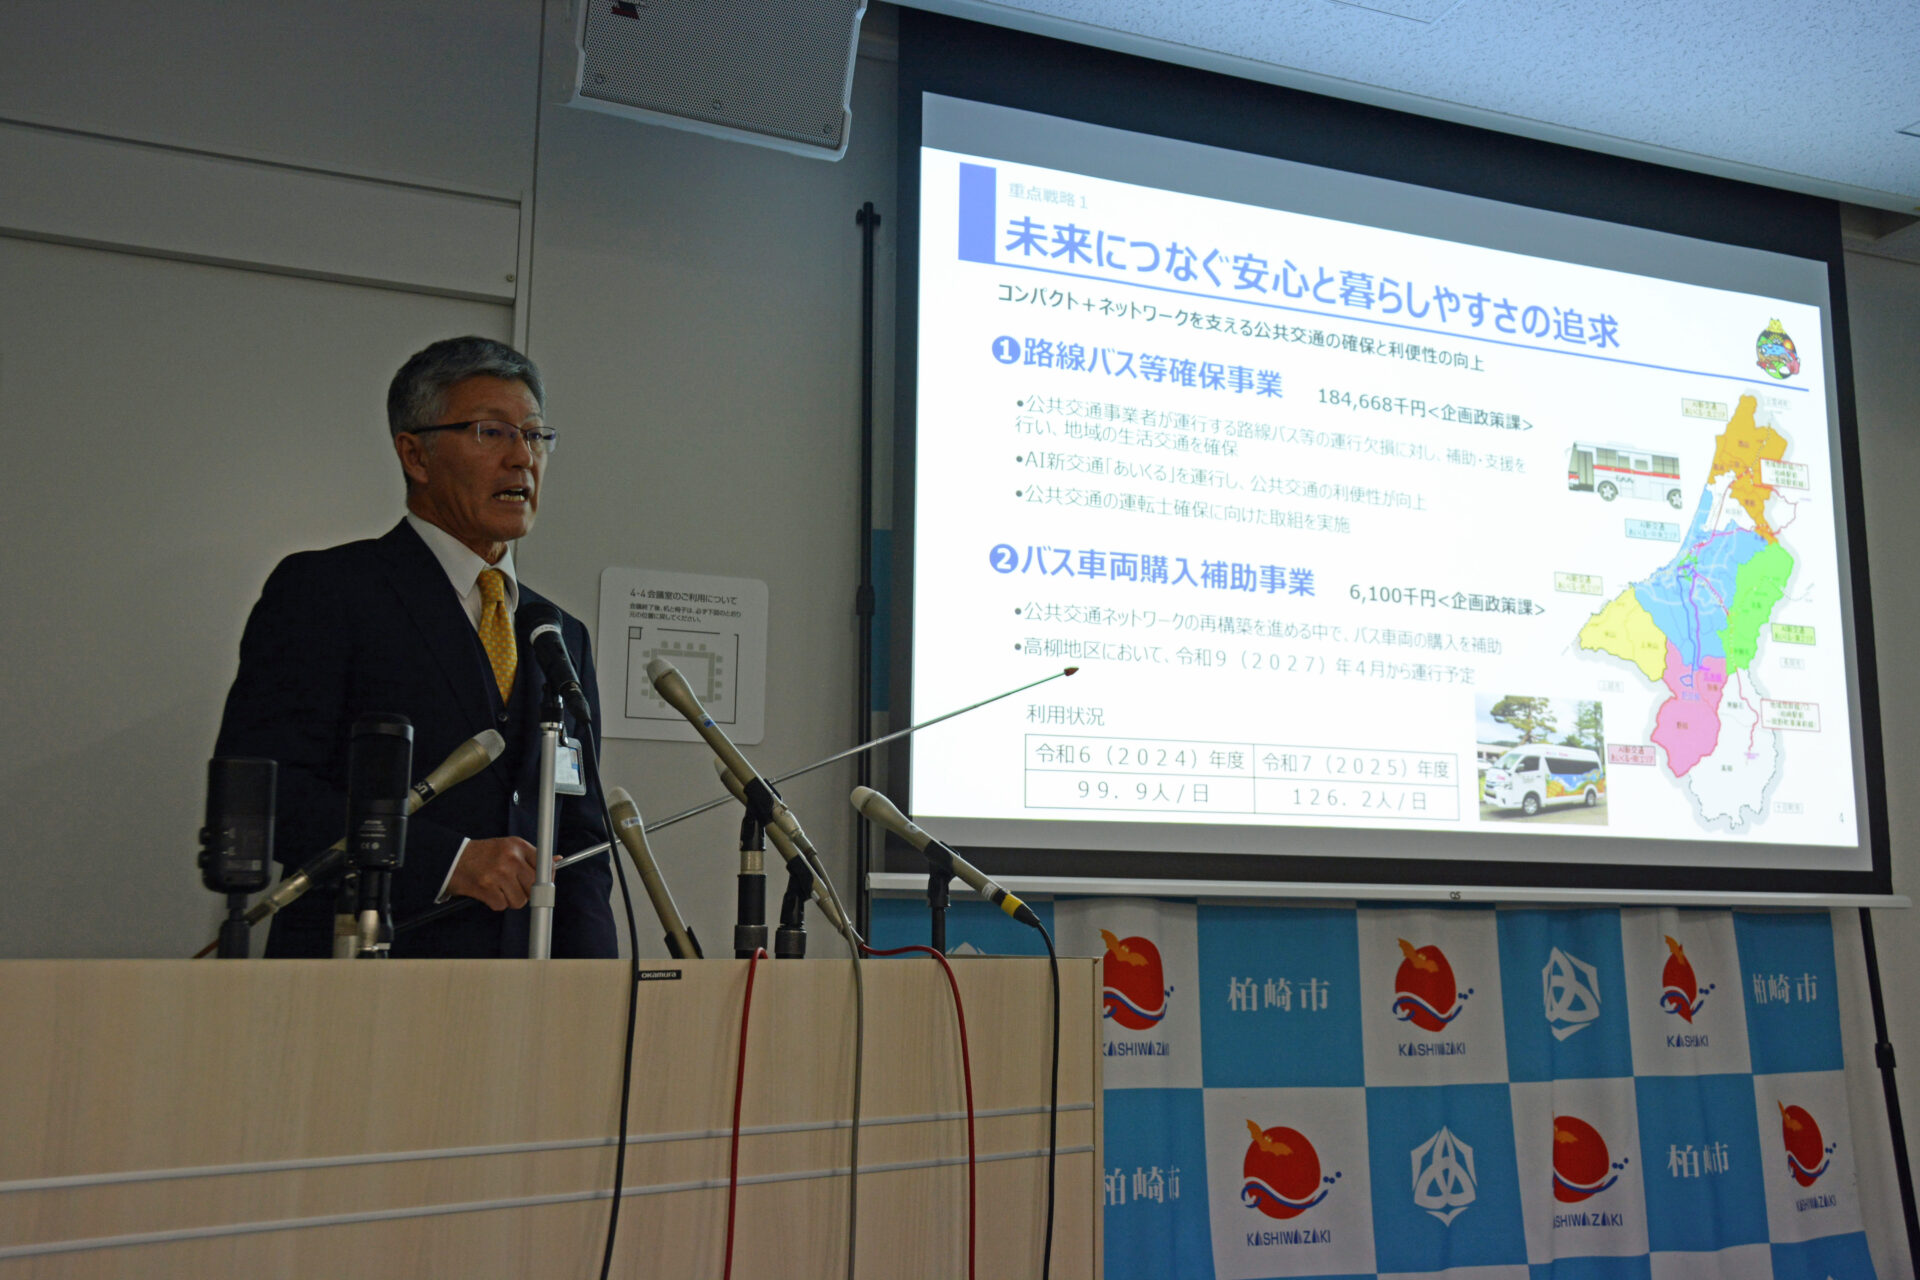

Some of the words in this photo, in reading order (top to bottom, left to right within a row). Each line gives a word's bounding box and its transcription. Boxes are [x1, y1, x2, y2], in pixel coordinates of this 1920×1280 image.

[1005, 216, 1621, 349] 未来につなぐ安心と暮らしやすさの追求
[1026, 704, 1105, 727] 利用状況
[1227, 977, 1331, 1012] 柏崎市
[1246, 1229, 1331, 1247] KASHIWAZAKI
